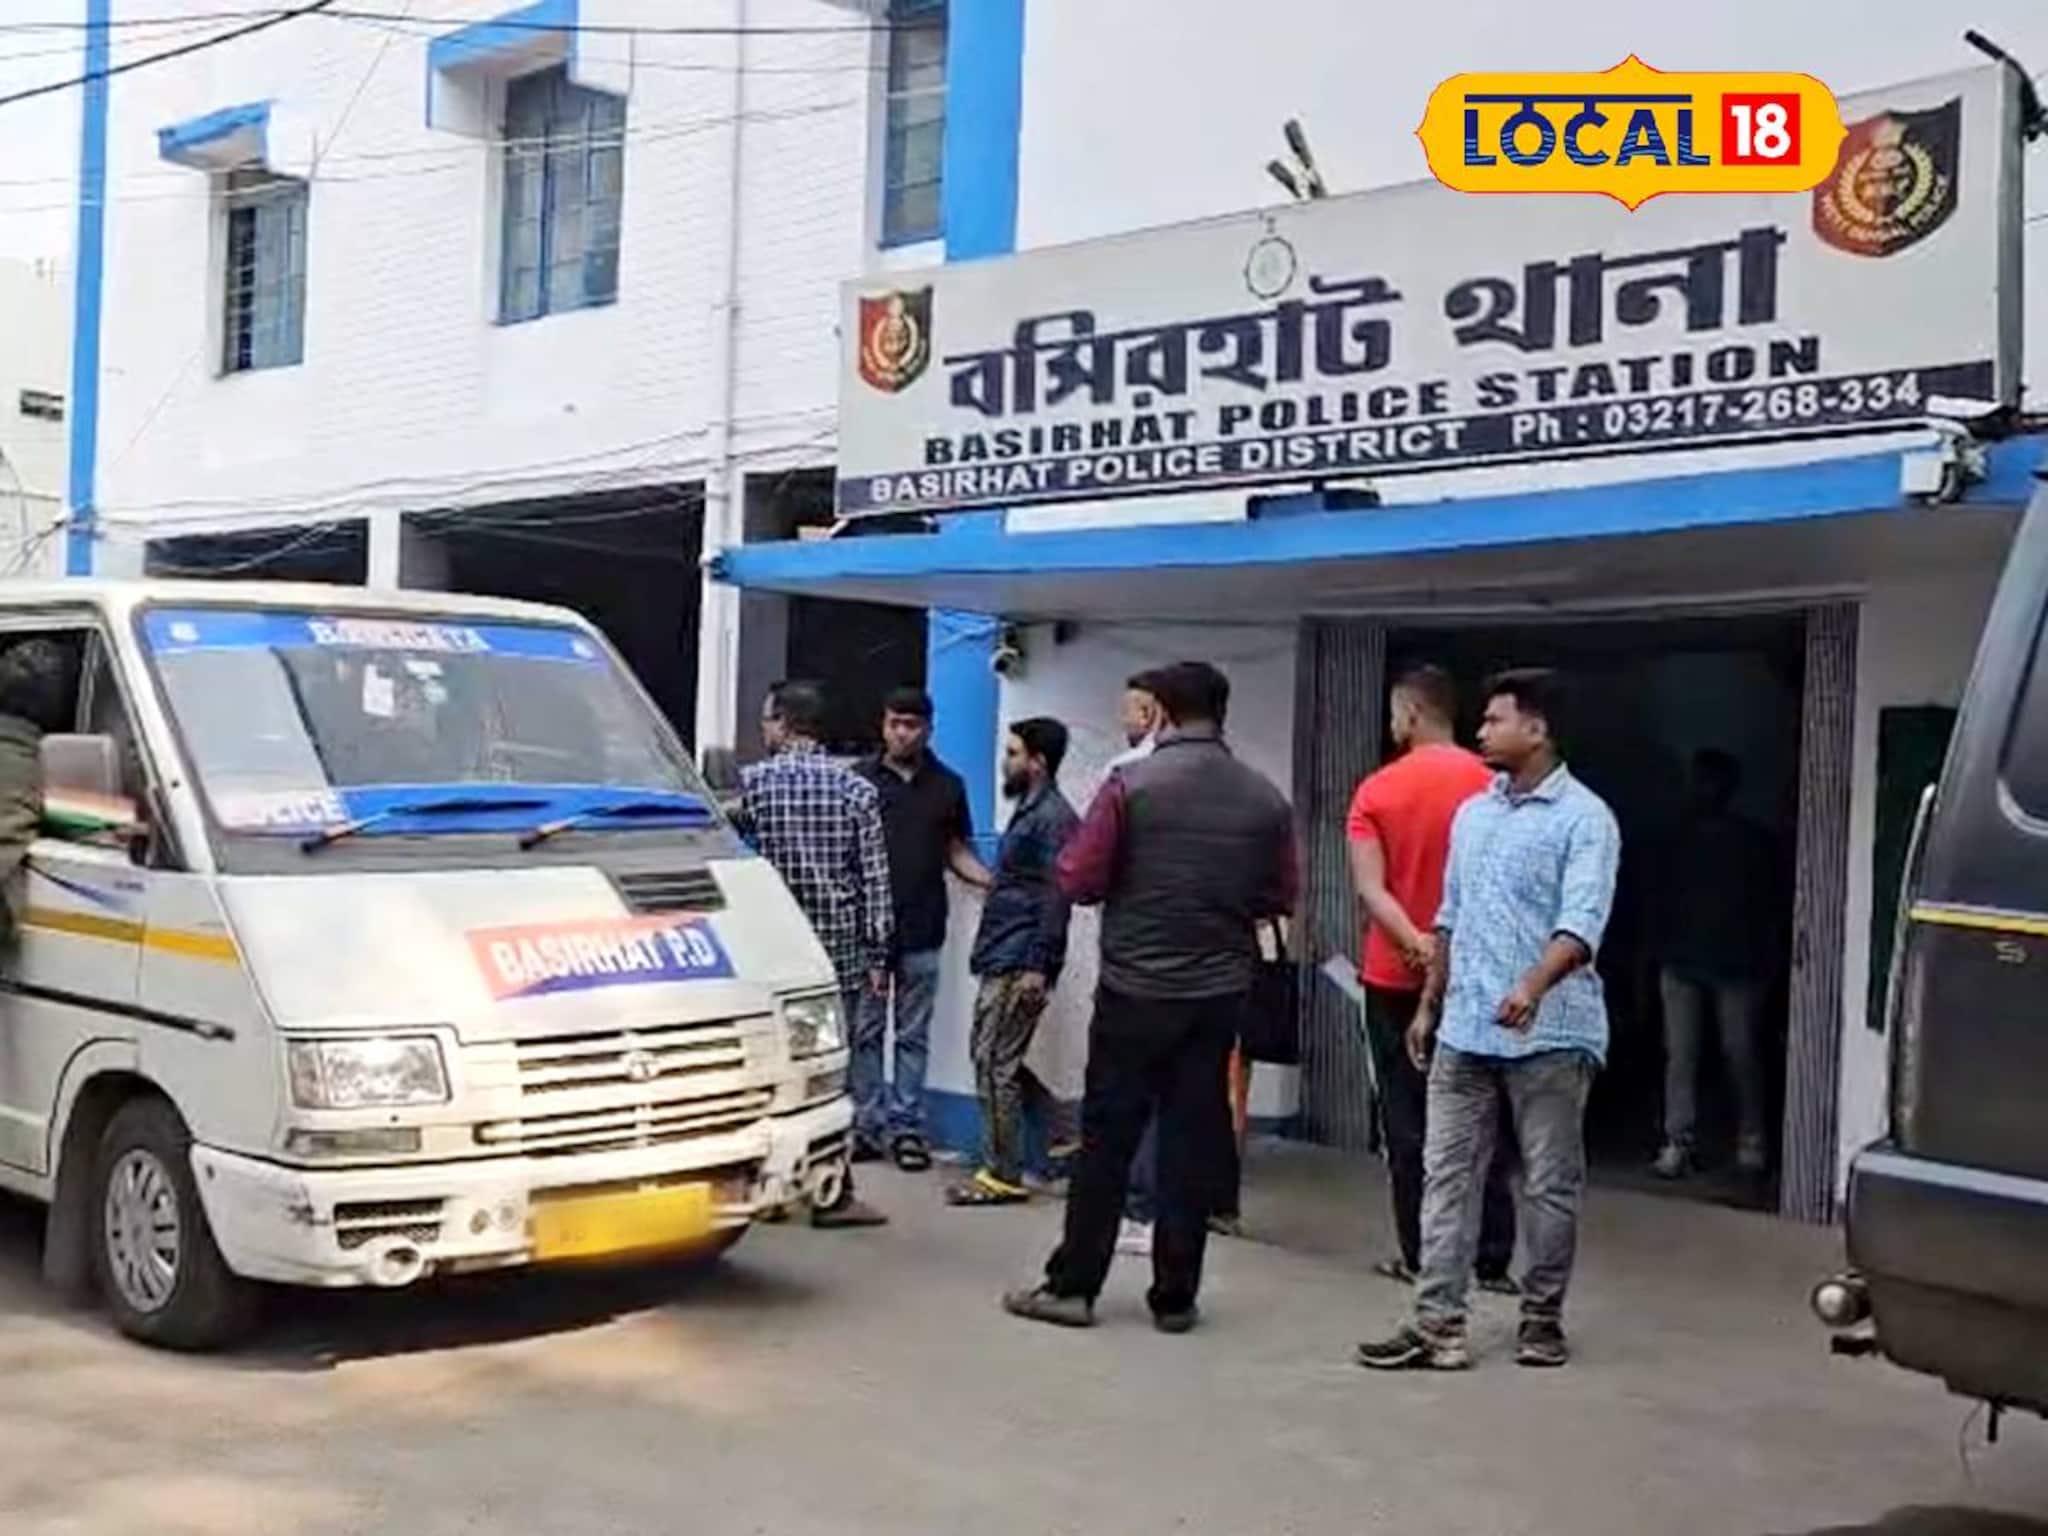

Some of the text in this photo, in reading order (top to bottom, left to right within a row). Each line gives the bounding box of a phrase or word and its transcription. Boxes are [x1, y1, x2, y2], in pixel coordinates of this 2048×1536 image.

[1445, 225, 1787, 353] থানা
[869, 461, 1056, 501] BASIRHAT
[1067, 443, 1222, 486] POLICE
[1240, 421, 1467, 470] DISTRICT
[1511, 413, 1560, 445] Ph
[1603, 373, 1922, 436] 03217-268-334
[924, 336, 1820, 464] BASIRHAT POLICE STATION
[490, 932, 664, 983] BASIRHAT
